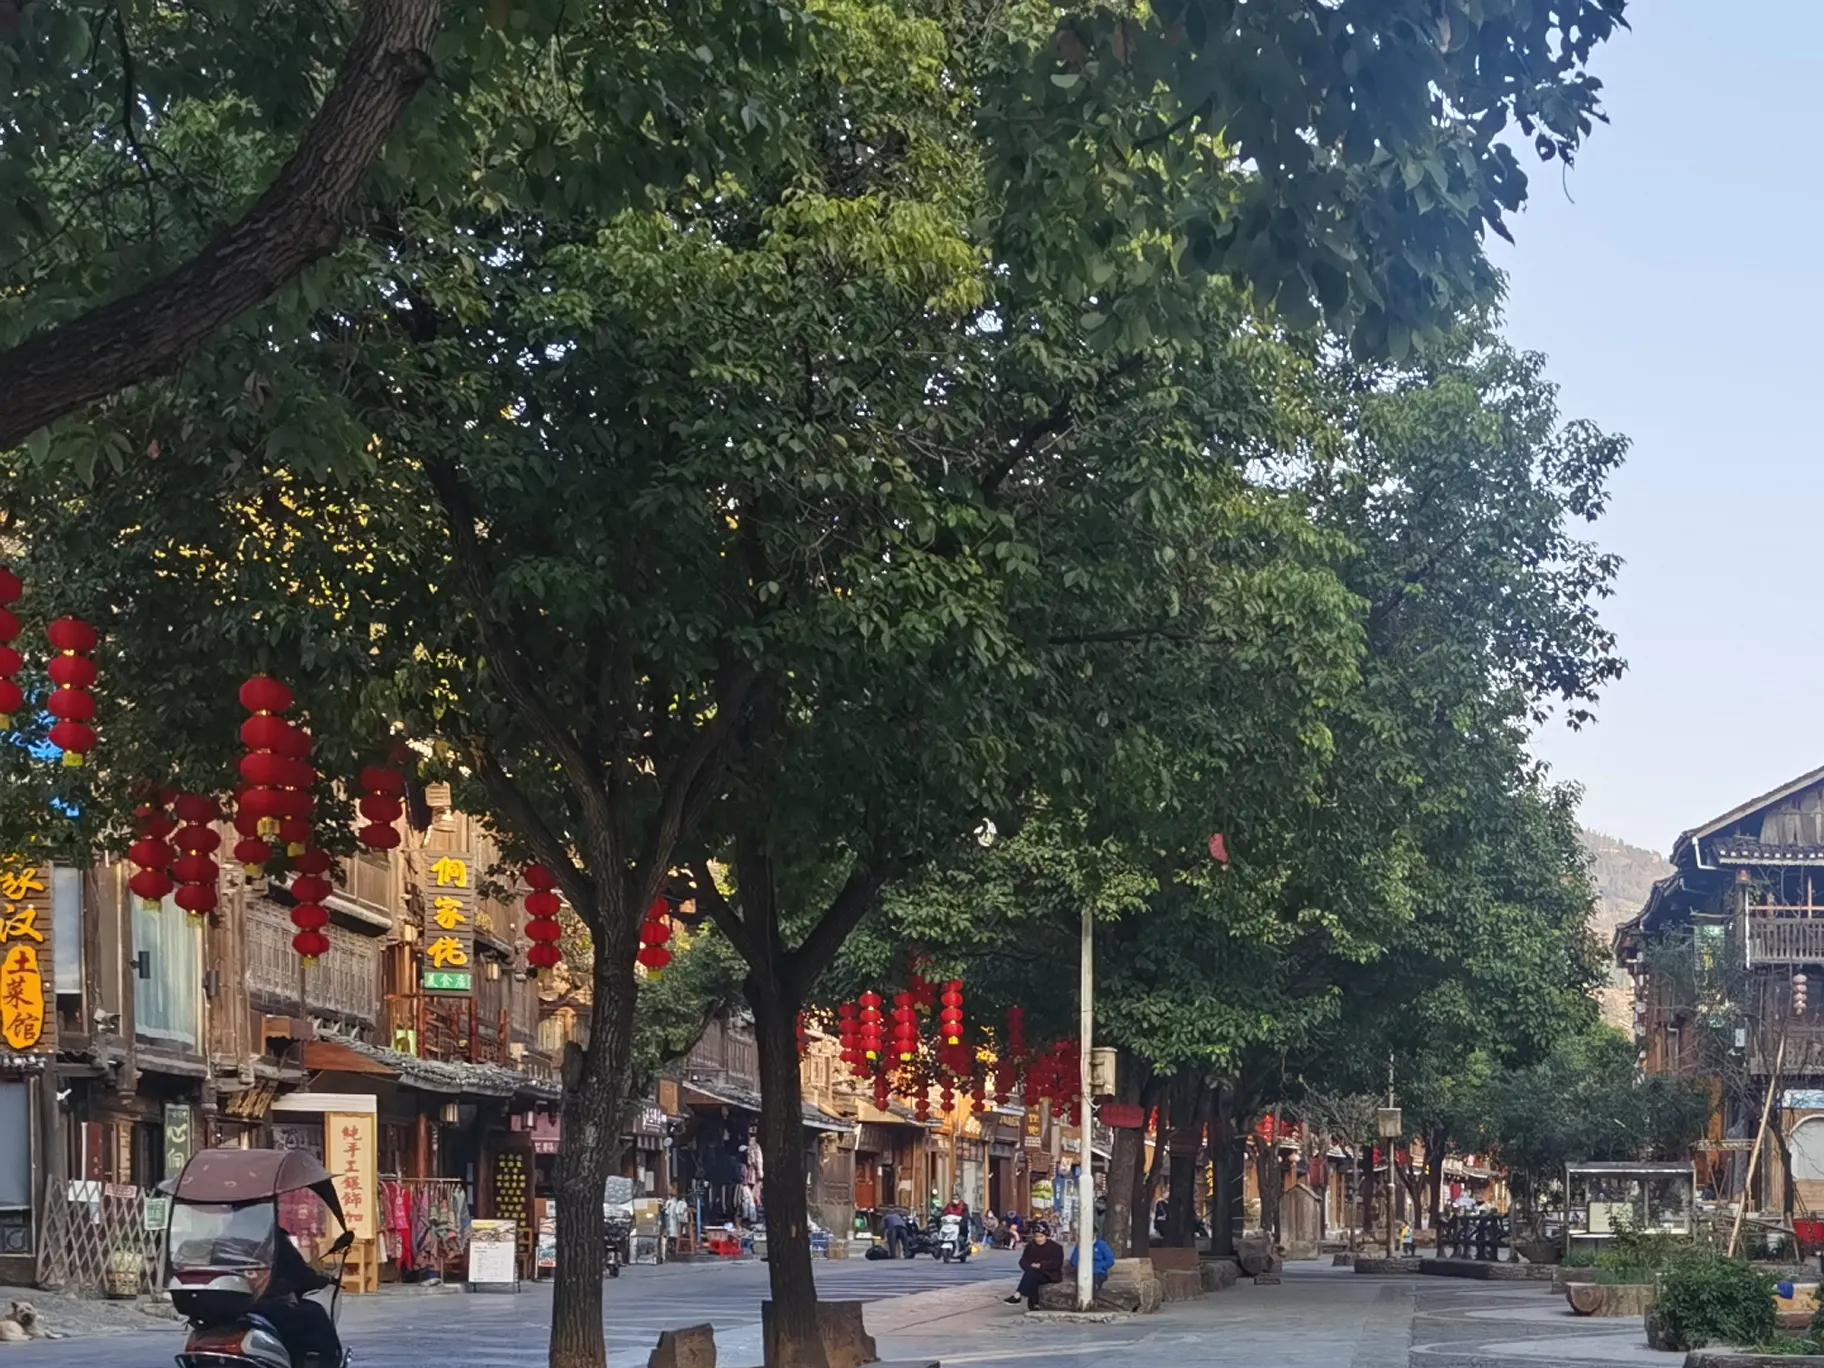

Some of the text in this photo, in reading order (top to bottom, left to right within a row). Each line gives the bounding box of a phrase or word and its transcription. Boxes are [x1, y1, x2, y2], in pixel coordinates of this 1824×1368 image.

[4, 951, 40, 1041] 土菜馆
[341, 1125, 364, 1230] 純手工銀飾加
